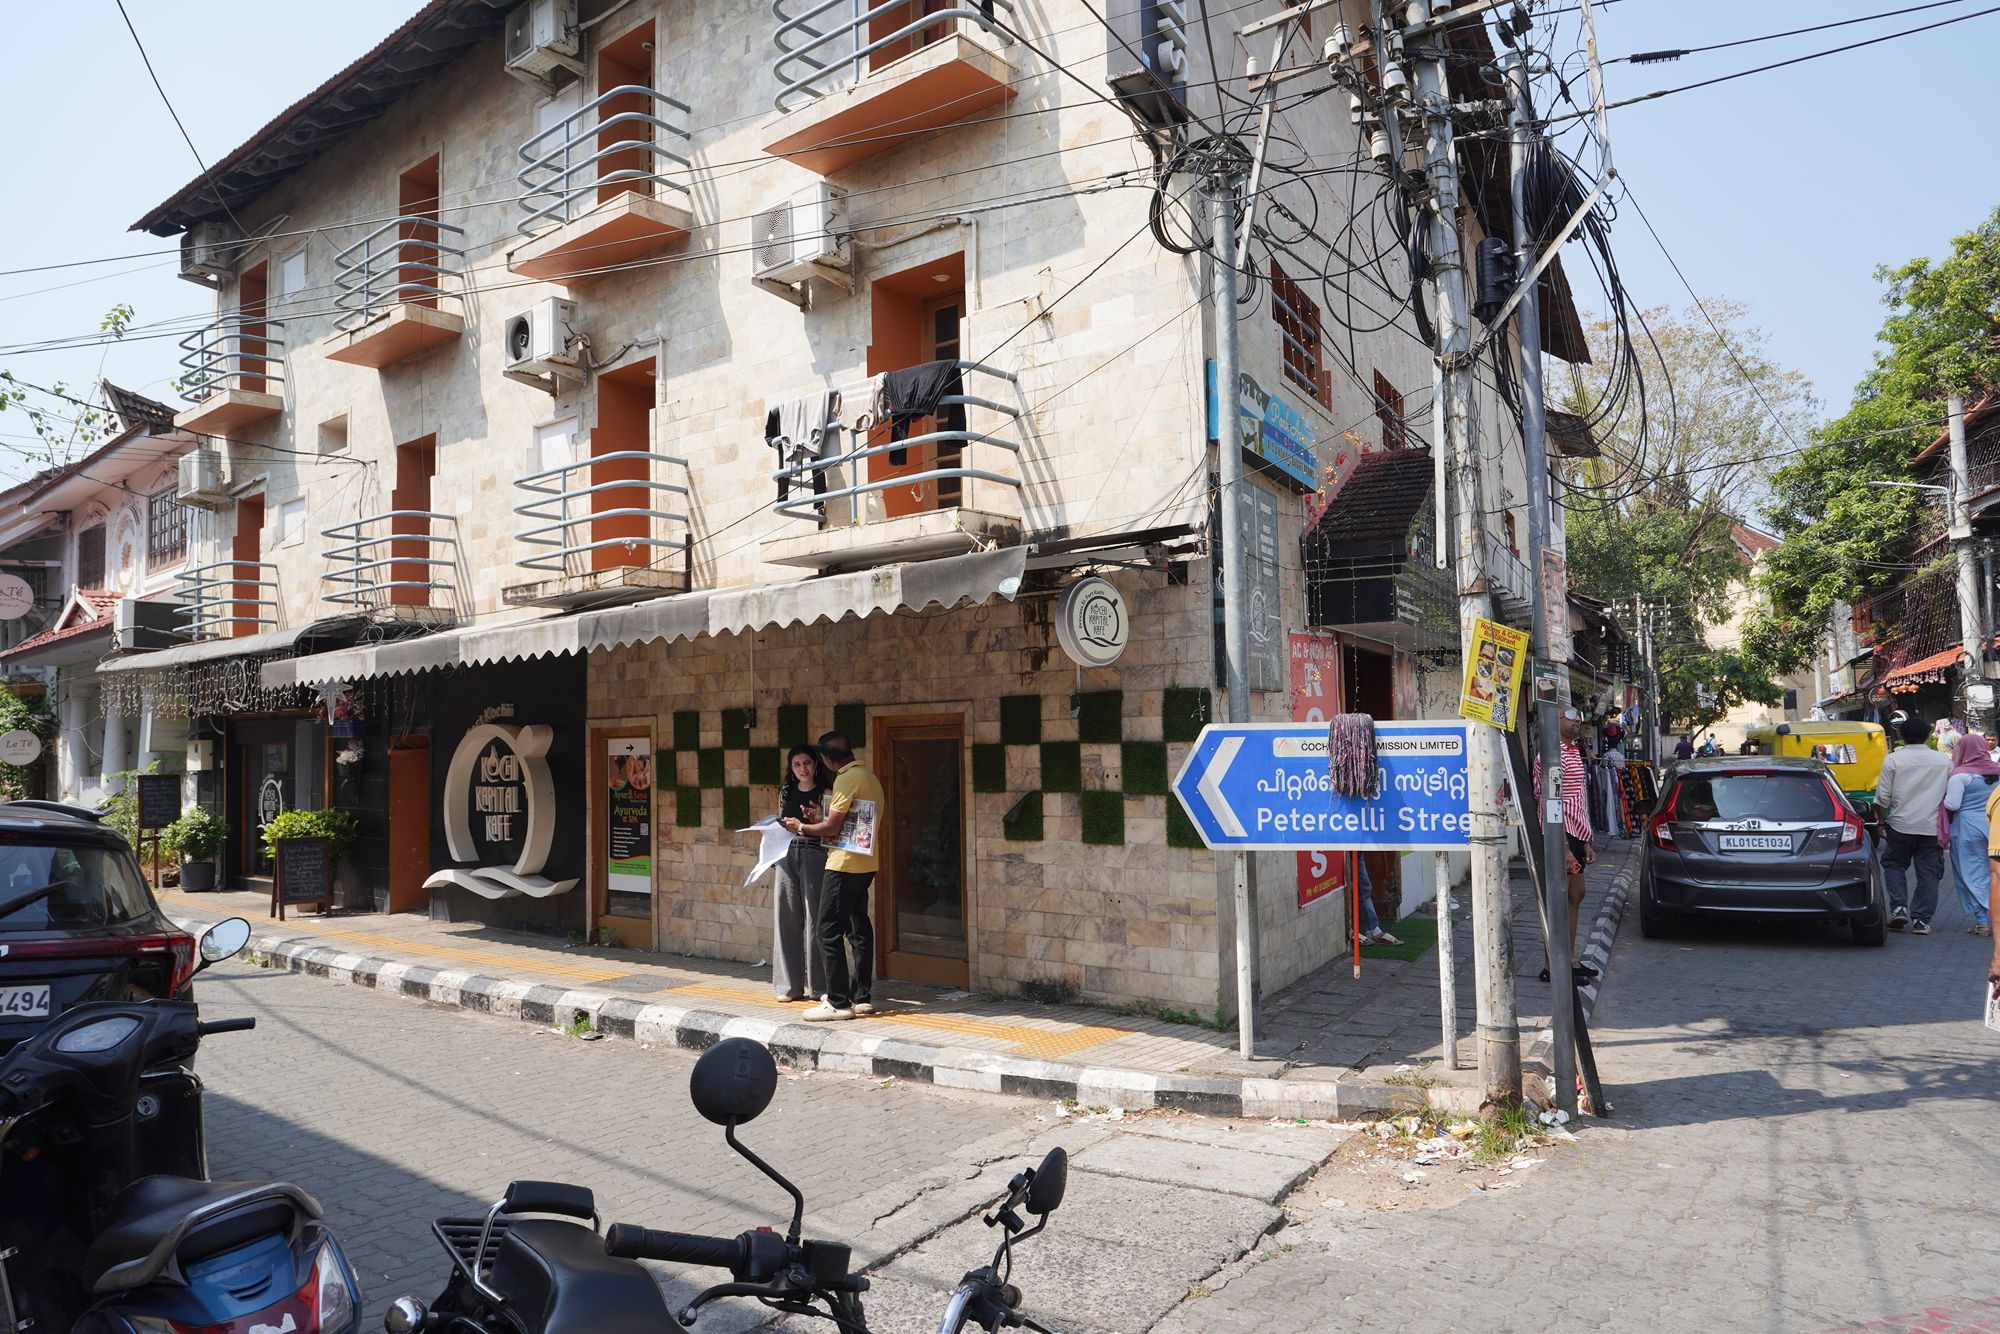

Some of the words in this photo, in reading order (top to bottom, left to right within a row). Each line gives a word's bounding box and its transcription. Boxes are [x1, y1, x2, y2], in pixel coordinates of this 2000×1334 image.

[1301, 742, 1329, 752] COCH
[1376, 741, 1417, 751] MISSION
[1420, 741, 1459, 750] LIMITED
[475, 785, 522, 813] KAPITAL
[613, 804, 648, 817] Ayurveda
[485, 814, 514, 842] KAFE
[1257, 806, 1386, 832] Petercelli
[1398, 806, 1471, 832] Stree
[1726, 838, 1791, 849] KL01CE1034
[0, 990, 49, 1013] 494
